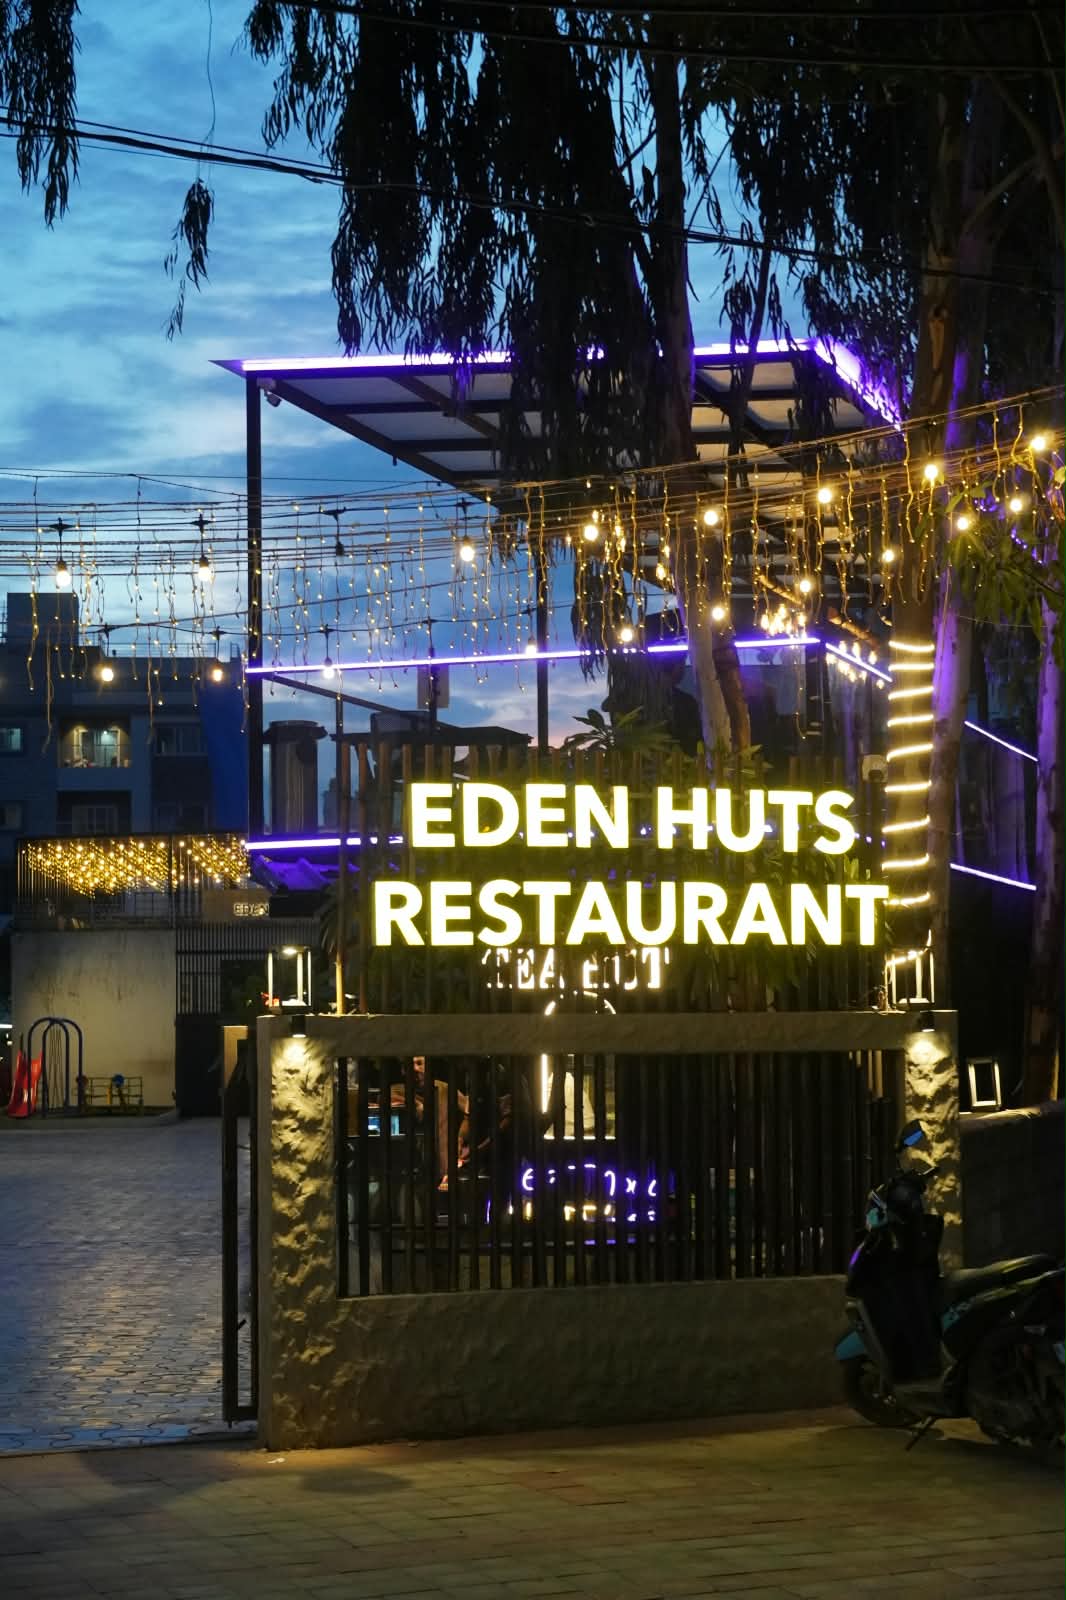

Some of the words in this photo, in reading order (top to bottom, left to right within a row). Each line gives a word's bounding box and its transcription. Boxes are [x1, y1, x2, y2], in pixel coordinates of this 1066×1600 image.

[410, 782, 629, 849] EDEN
[656, 786, 856, 855] HUTS
[373, 878, 890, 947] RESTAURANT
